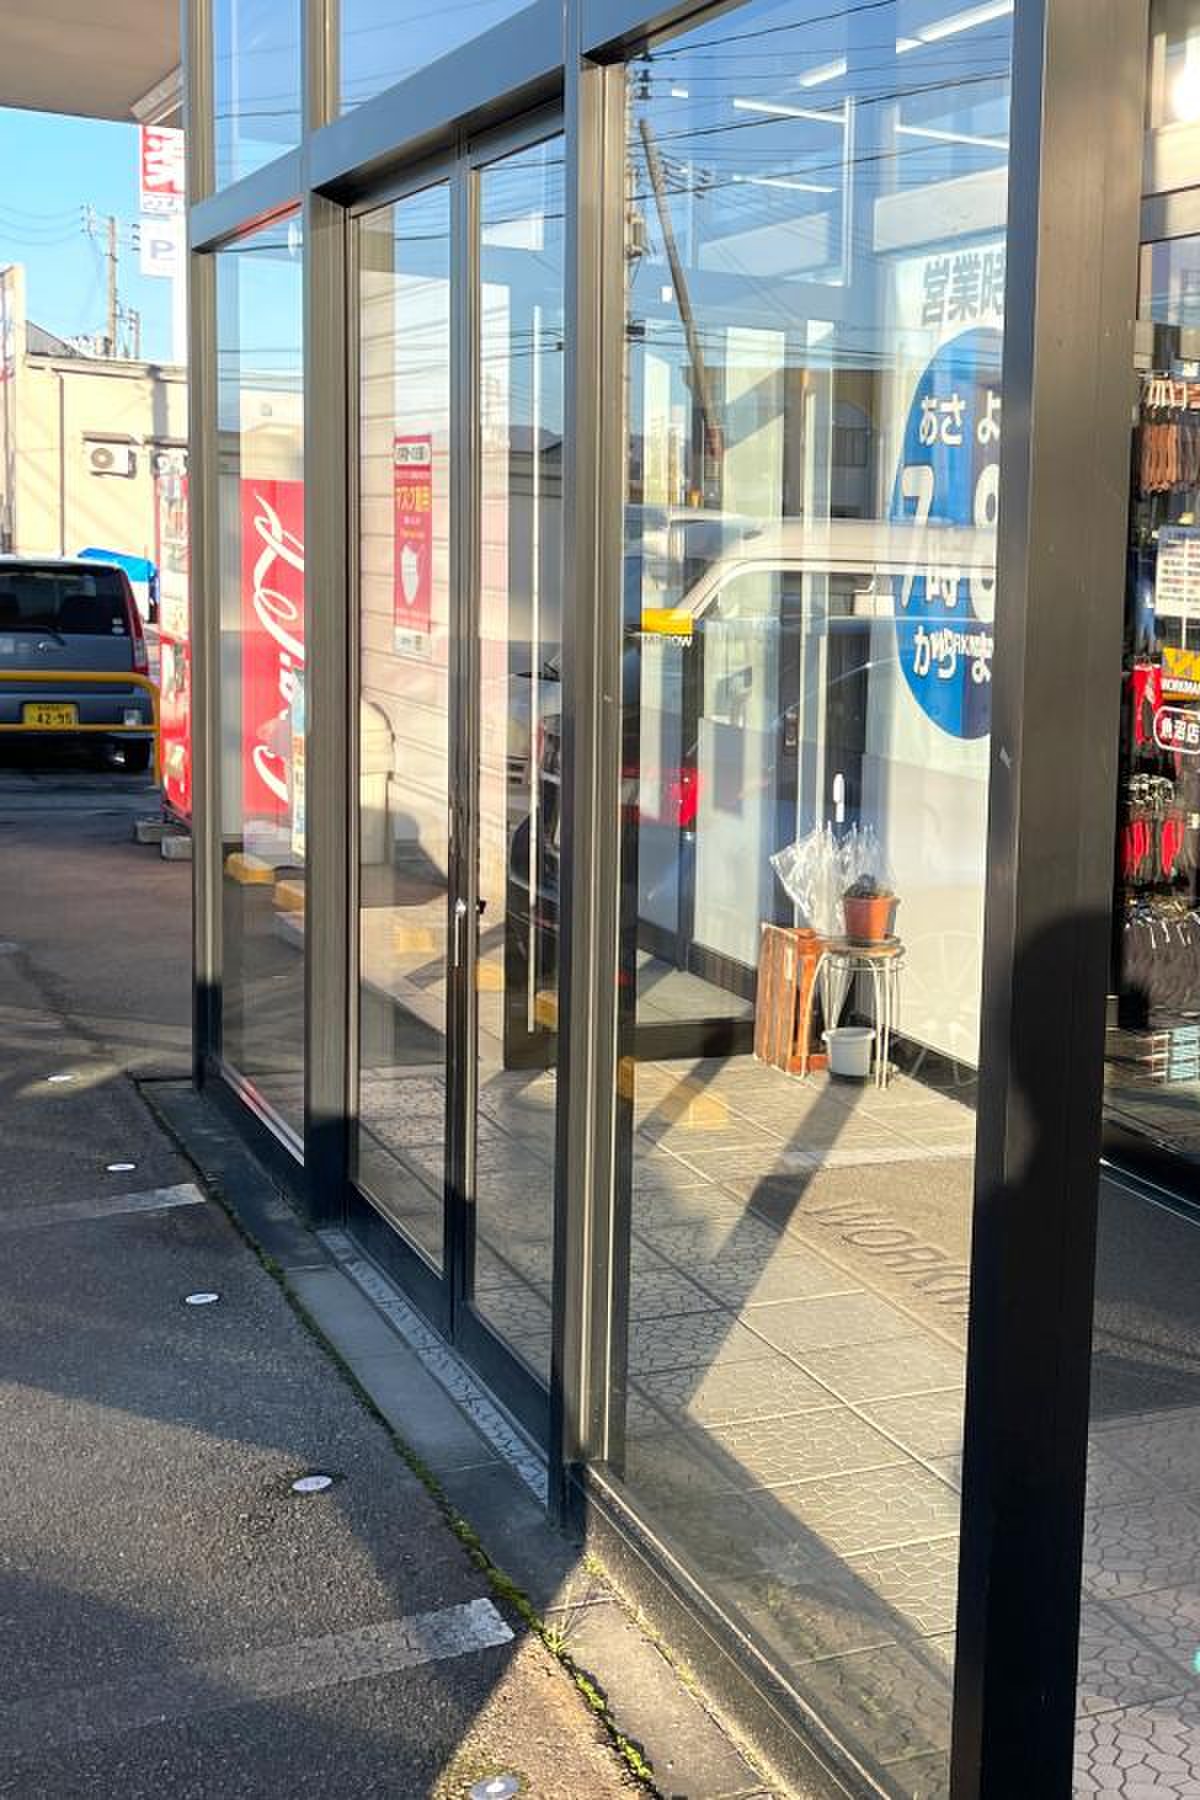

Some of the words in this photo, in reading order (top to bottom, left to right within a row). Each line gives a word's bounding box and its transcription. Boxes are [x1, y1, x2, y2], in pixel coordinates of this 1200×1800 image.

[919, 393, 965, 446] あさ
[977, 390, 1000, 443] よ
[1161, 715, 1200, 744] 魚沼店
